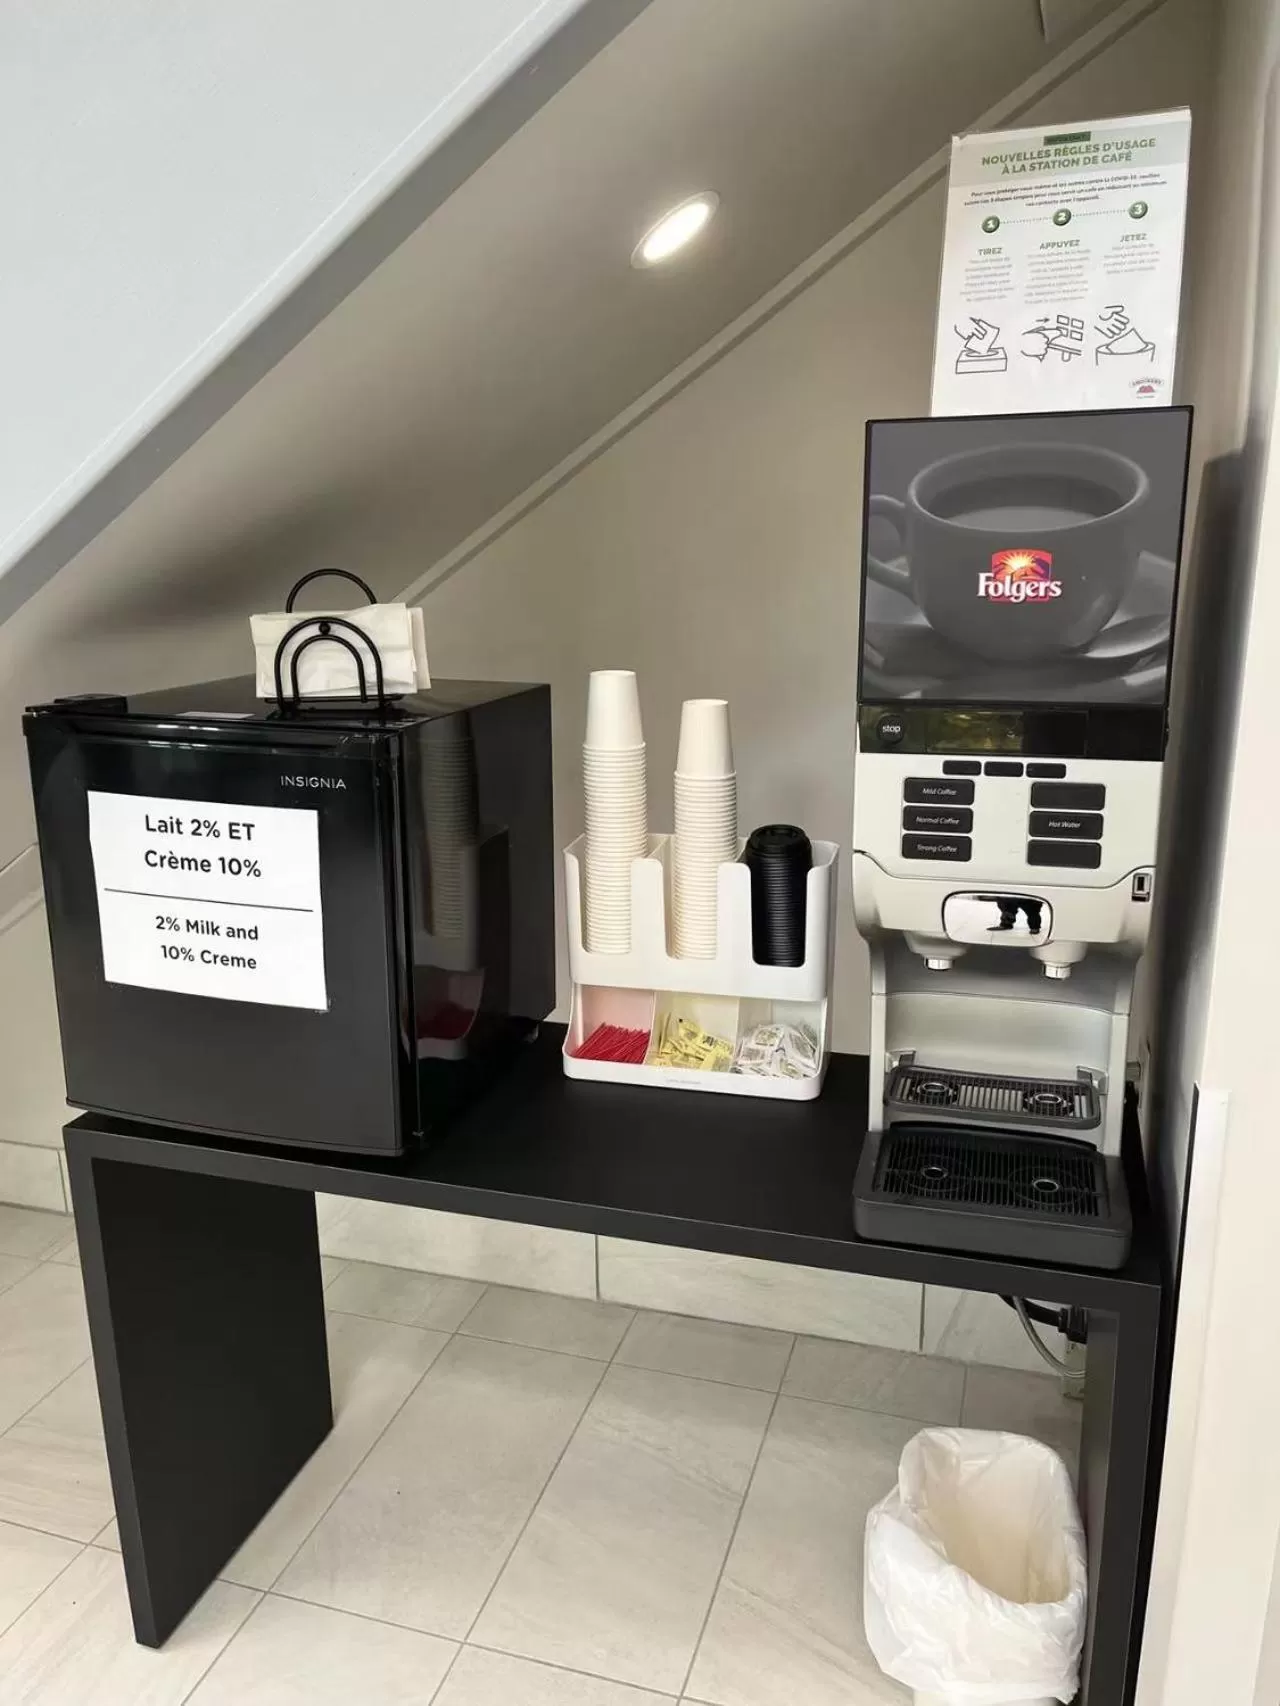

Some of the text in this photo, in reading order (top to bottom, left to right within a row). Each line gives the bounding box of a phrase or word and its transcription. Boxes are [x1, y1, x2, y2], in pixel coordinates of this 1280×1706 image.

[982, 149, 1050, 166] NOUVELLES
[1054, 143, 1100, 158] RÈGLES
[1103, 138, 1156, 152] D'USAGE
[1002, 150, 1132, 175] À LA STATION DE CAFÉ
[1040, 240, 1080, 250] APPUYEZ
[1120, 233, 1148, 243] JETEZ
[978, 248, 1002, 256] TIREZ
[977, 572, 1062, 603] Folgers
[882, 724, 900, 734] stop
[280, 775, 347, 790] INSIGNIA
[922, 787, 958, 796] Mild Coffee
[145, 814, 255, 840] Lait 2% ET
[916, 816, 939, 824] Normal
[917, 844, 937, 852] Strong
[144, 850, 262, 878] Crème 10%
[155, 916, 259, 940] 2% Milk and
[160, 946, 257, 969] 10% Creme
